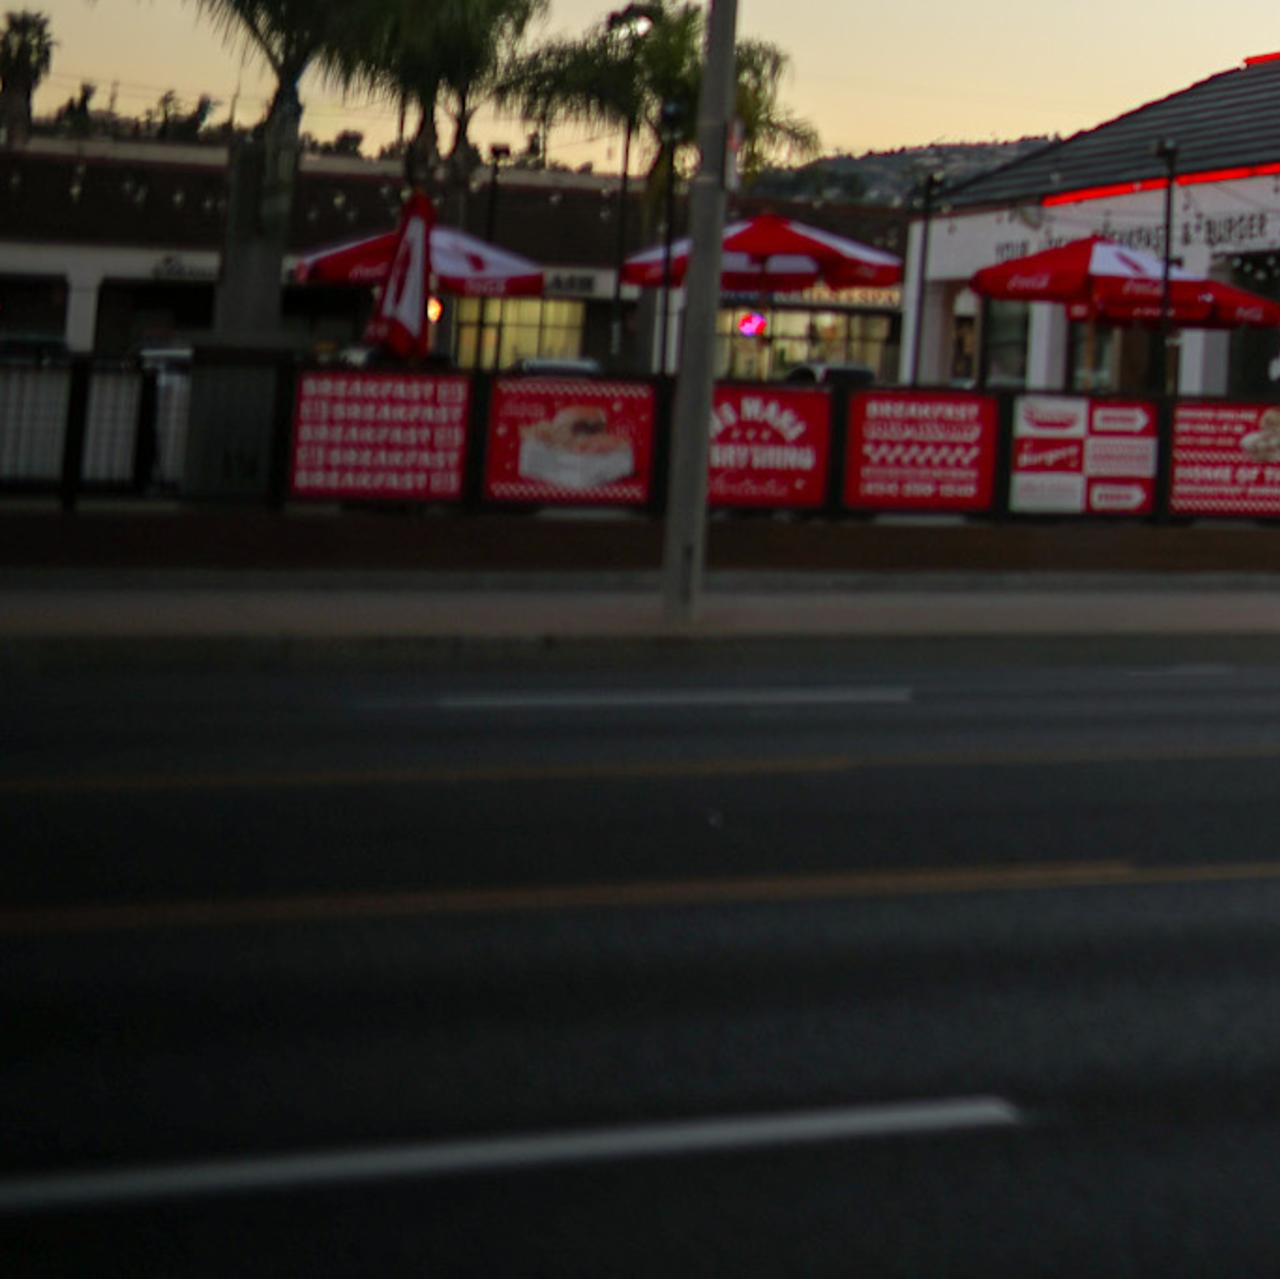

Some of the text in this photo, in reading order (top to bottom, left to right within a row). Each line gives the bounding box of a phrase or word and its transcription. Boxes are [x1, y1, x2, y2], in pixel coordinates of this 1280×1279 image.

[302, 379, 434, 400] BREAKFAST
[332, 403, 464, 424] BREAKFAST
[866, 400, 980, 420] BREAKFAST
[299, 425, 431, 446] BREAKFAST
[329, 449, 460, 470] BREAKFAST
[294, 471, 428, 491] BREAKFAST
[1175, 466, 1232, 483] HOME
